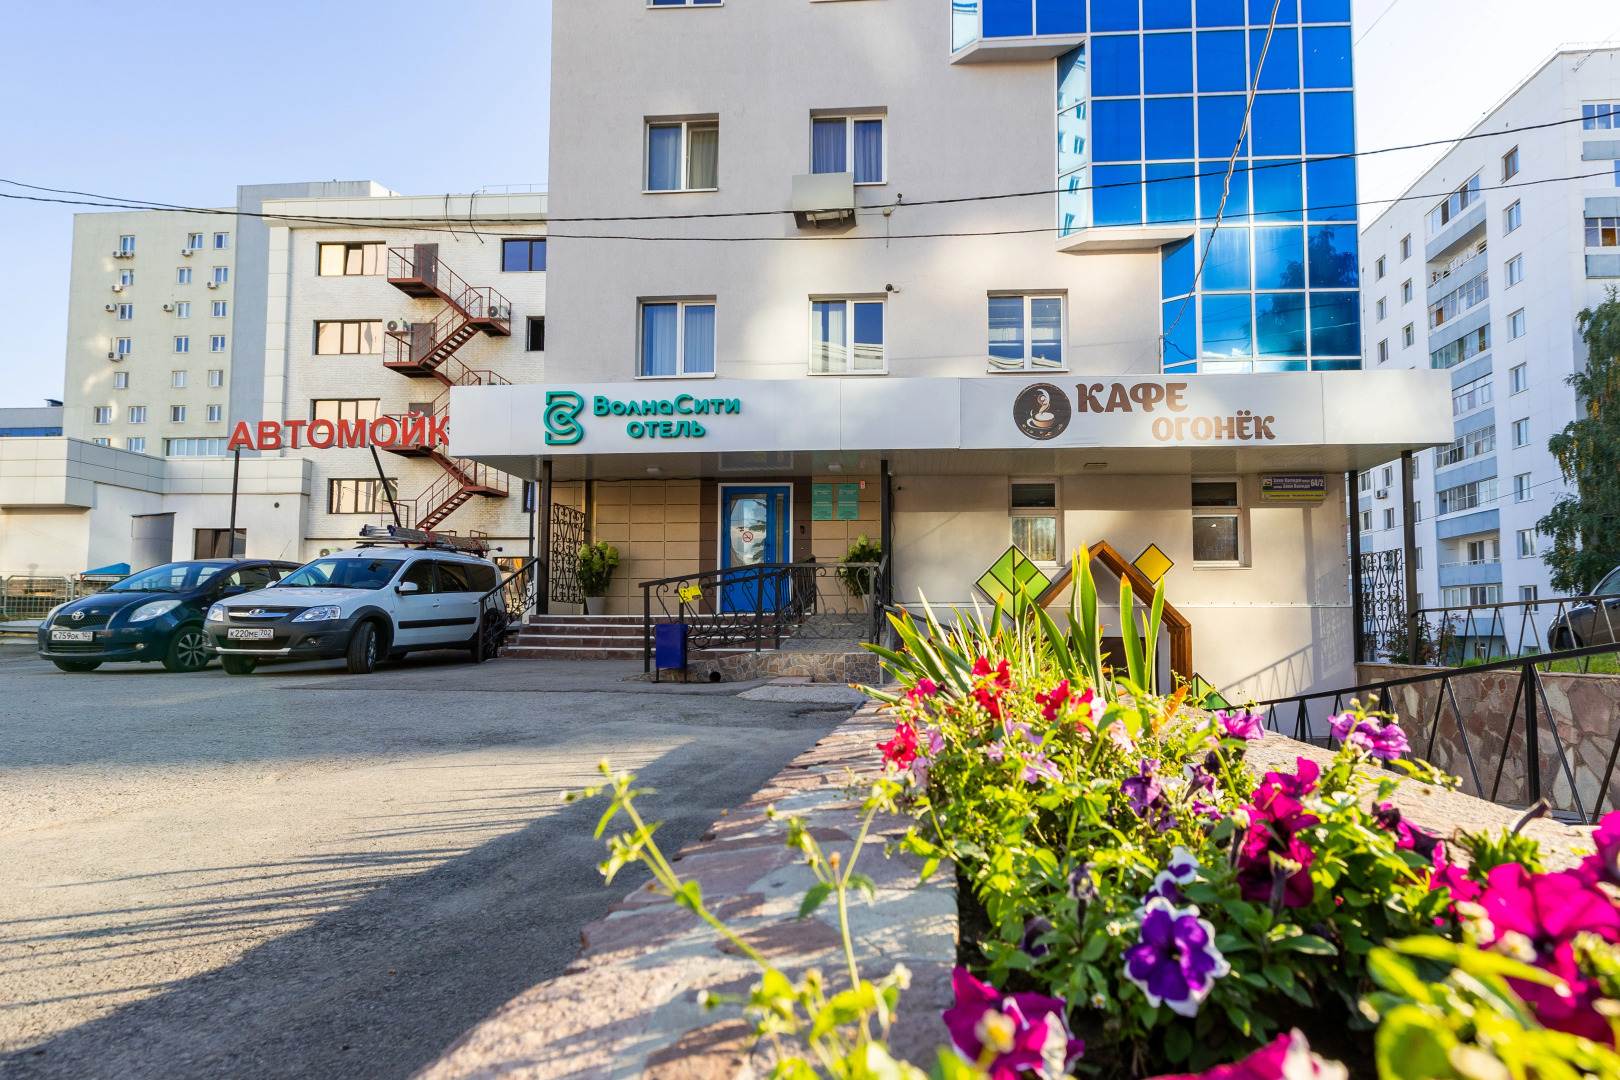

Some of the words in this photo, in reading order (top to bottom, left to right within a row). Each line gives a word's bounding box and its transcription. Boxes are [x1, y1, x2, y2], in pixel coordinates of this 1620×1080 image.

[593, 393, 741, 417] ВолнаСити
[1075, 382, 1188, 413] КАФЕ
[227, 410, 450, 450] АВТОМОЙК
[626, 420, 706, 439] ОТЕЛЬ
[1151, 410, 1276, 442] ОГОНЁК
[1310, 478, 1324, 487] 64/2
[53, 631, 80, 640] К759ОК
[230, 630, 259, 638] К220МЕ
